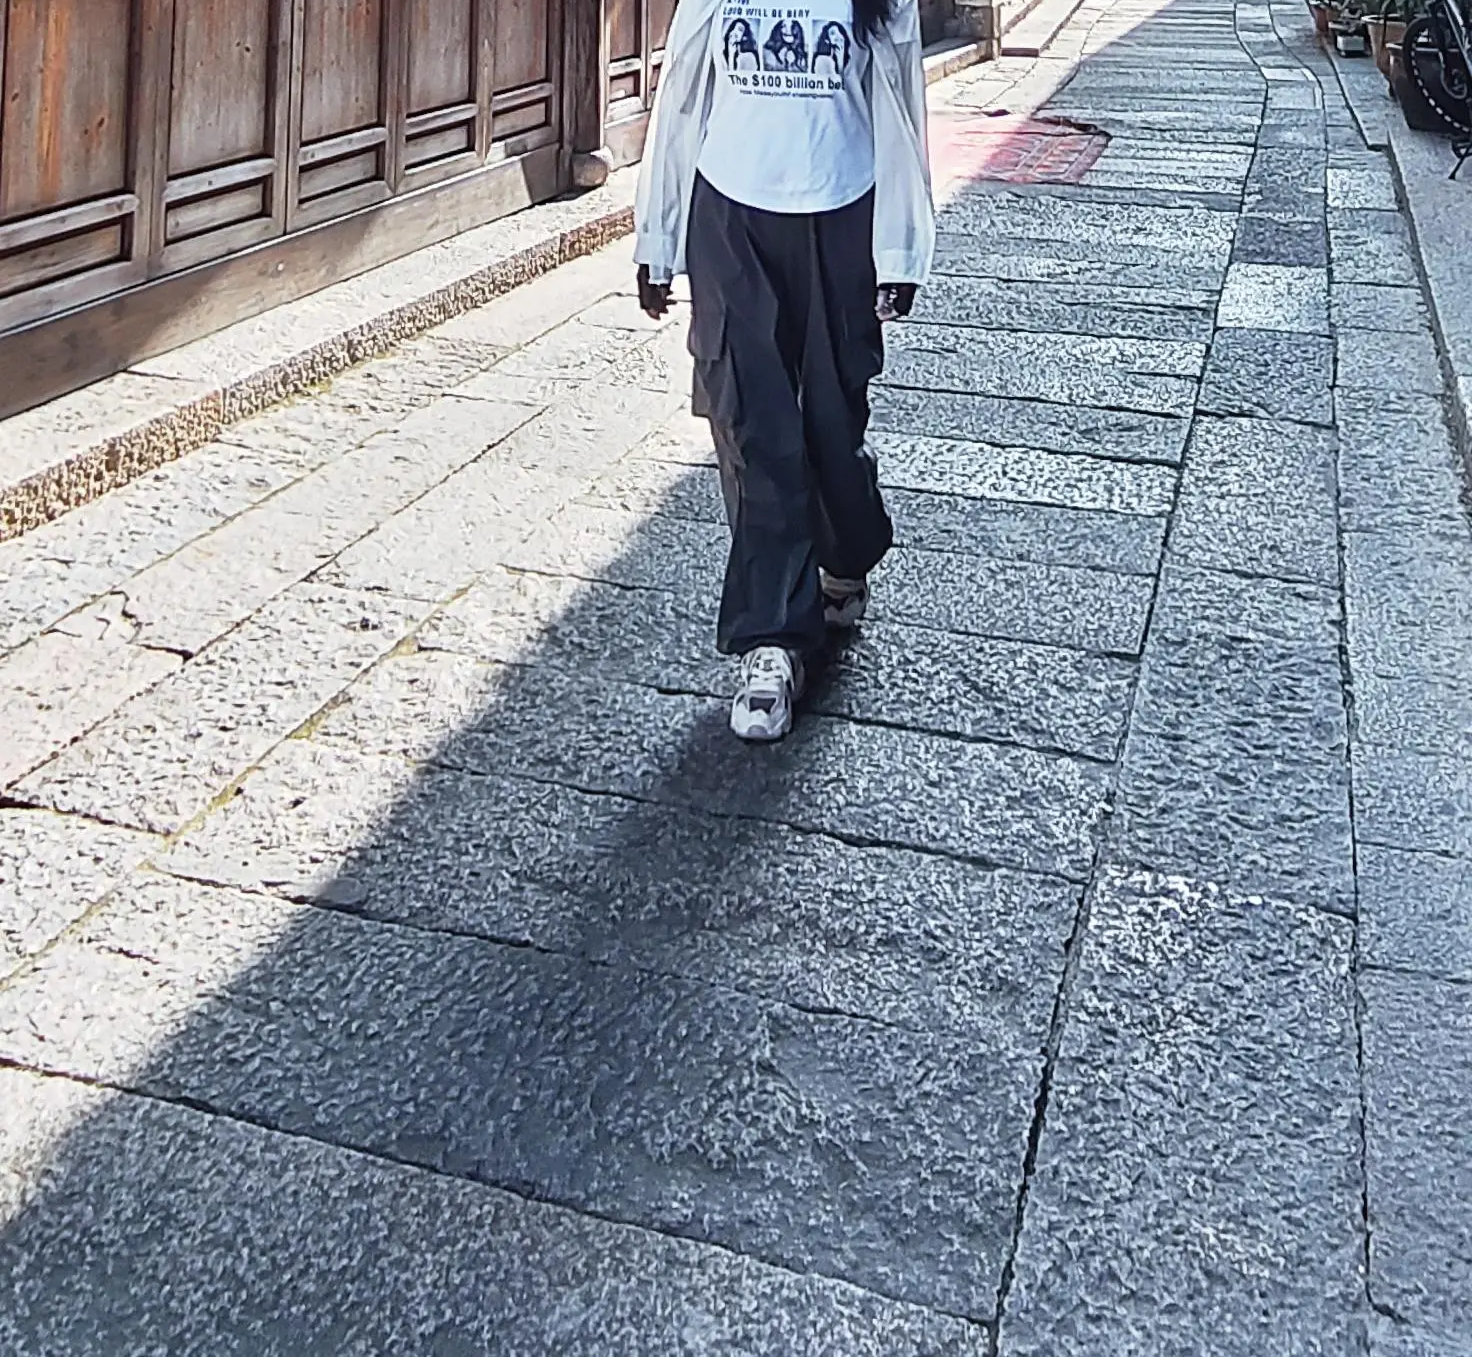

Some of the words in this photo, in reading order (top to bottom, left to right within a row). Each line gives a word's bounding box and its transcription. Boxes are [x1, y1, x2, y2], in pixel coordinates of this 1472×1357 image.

[728, 75, 748, 86] The
[752, 74, 781, 88] $100
[785, 76, 824, 90] billion
